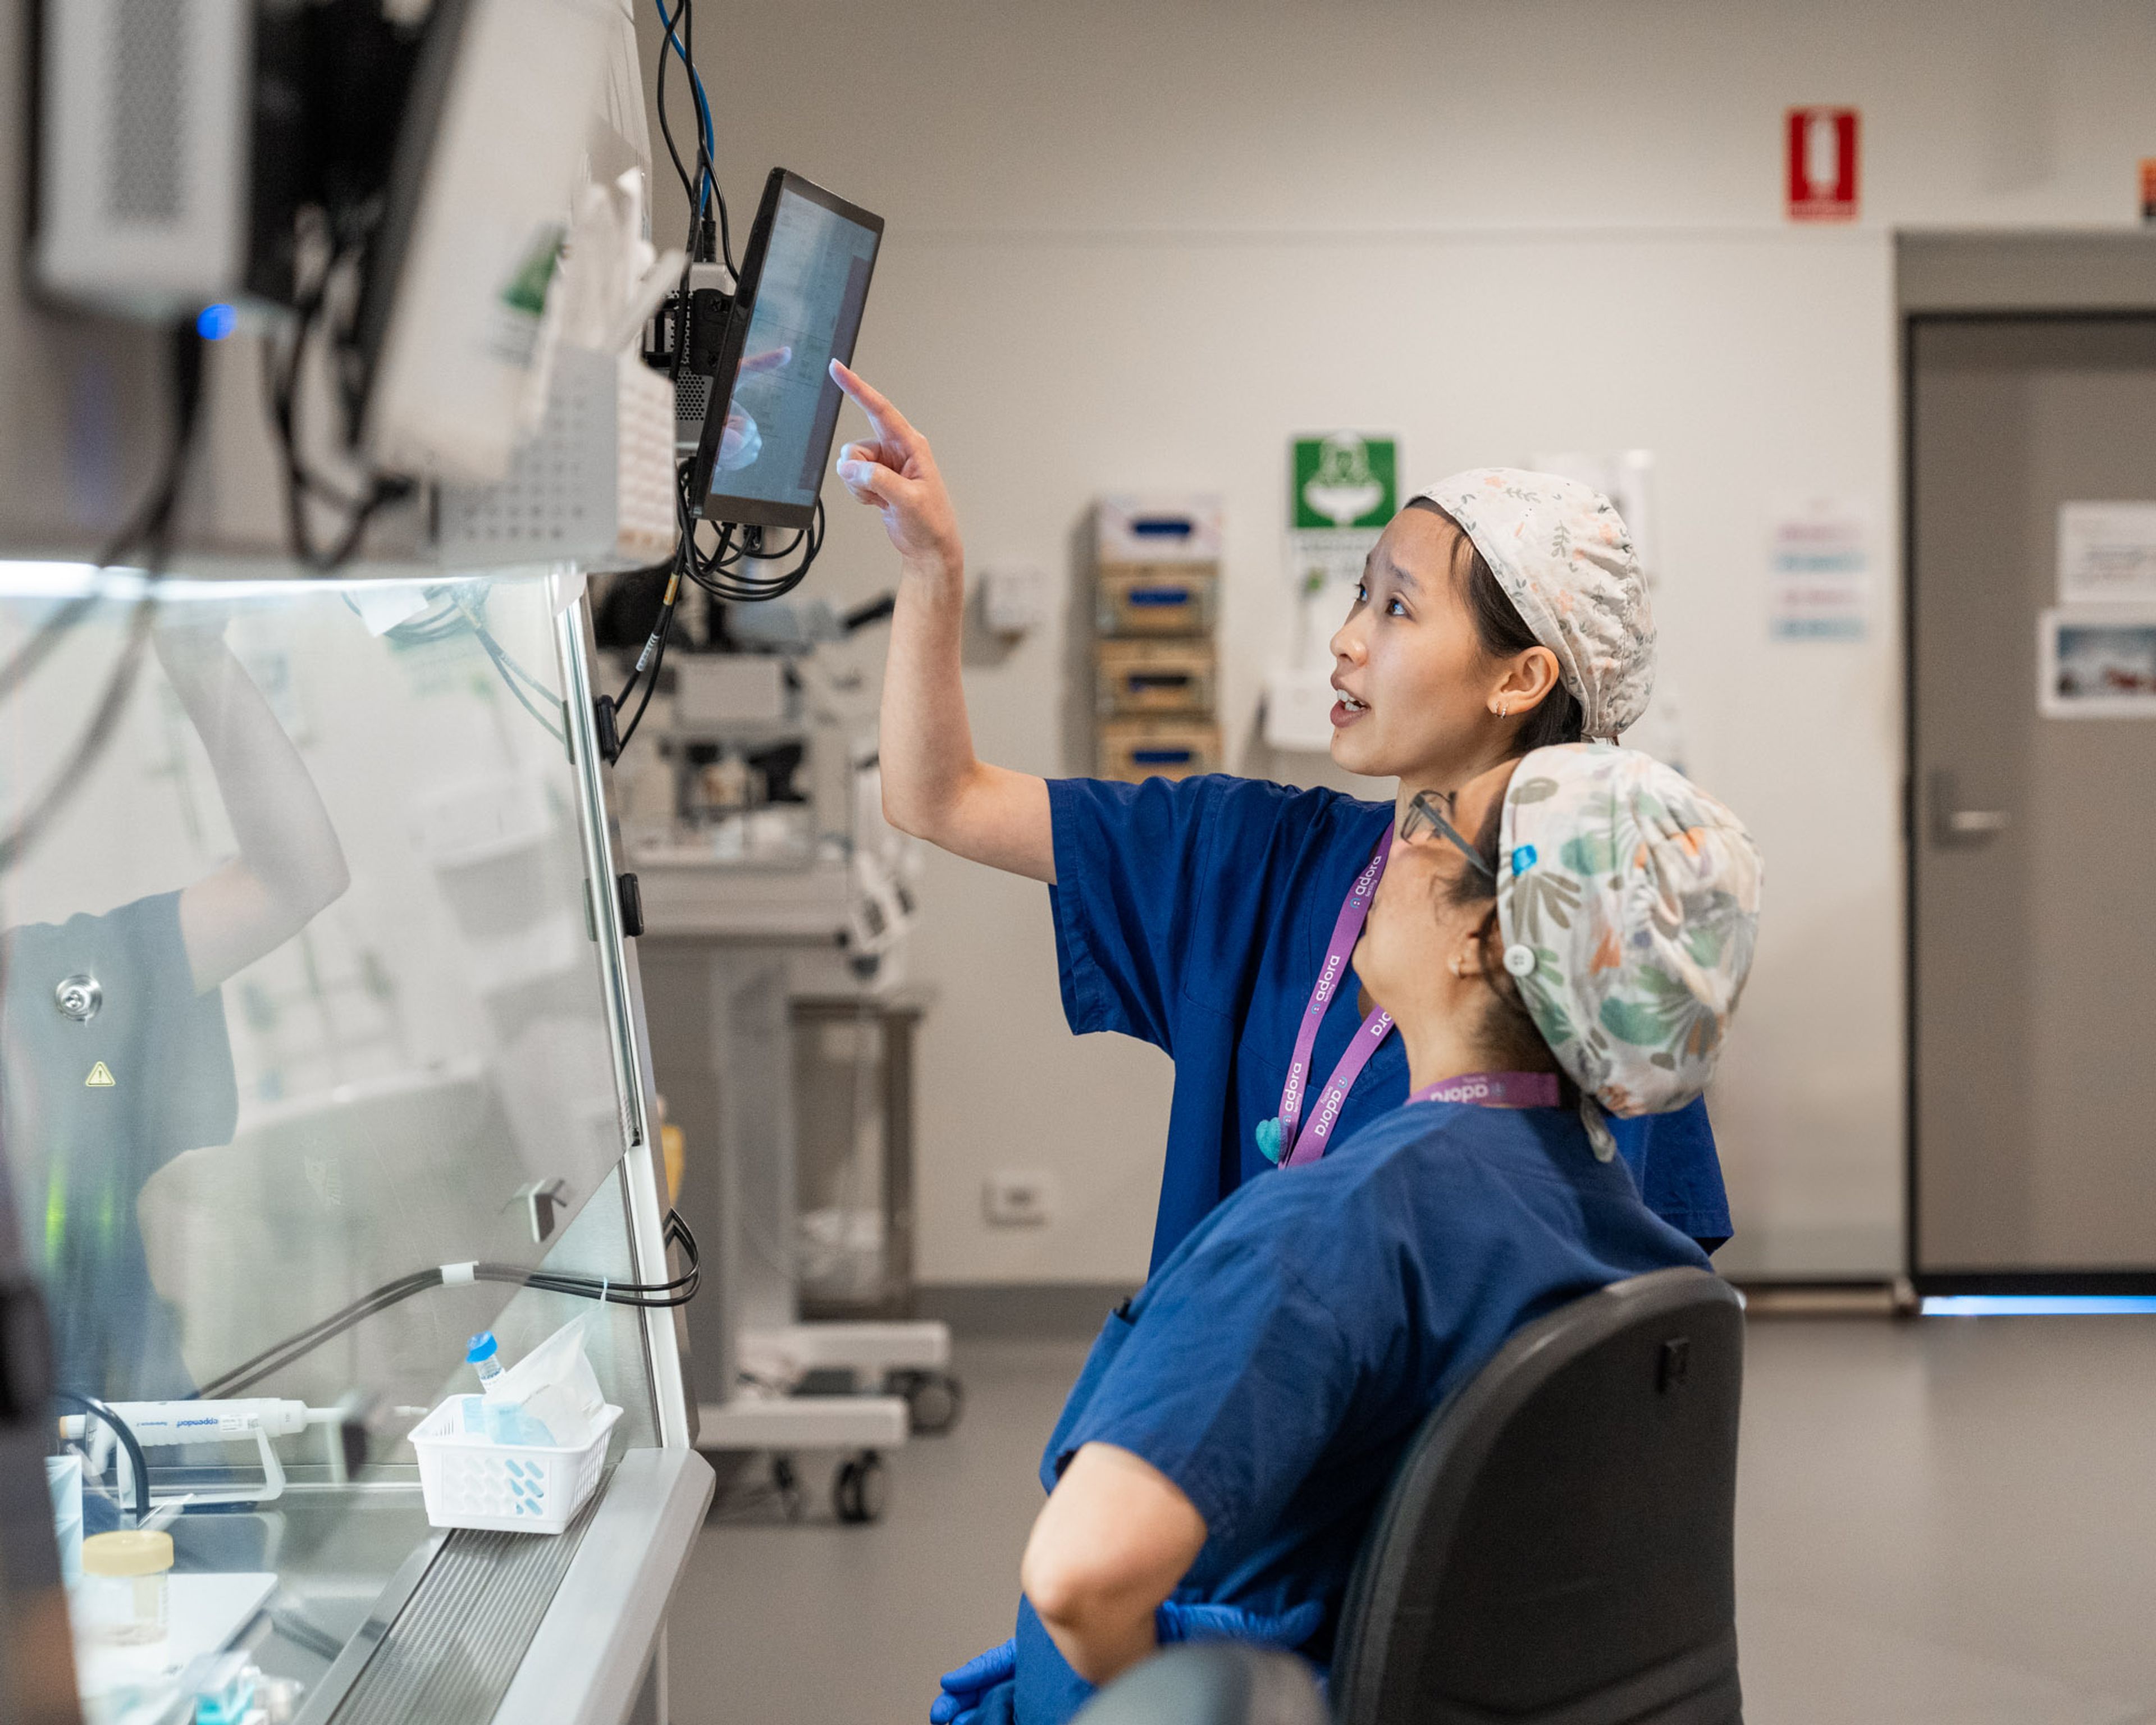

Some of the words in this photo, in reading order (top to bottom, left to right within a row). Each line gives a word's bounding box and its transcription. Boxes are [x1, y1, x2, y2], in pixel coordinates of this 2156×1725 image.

[1355, 855, 1382, 895] adora
[1315, 955, 1340, 1001] adora
[1370, 1011, 1392, 1037] ora
[1285, 1062, 1302, 1112] adora
[1314, 1090, 1341, 1137] adora
